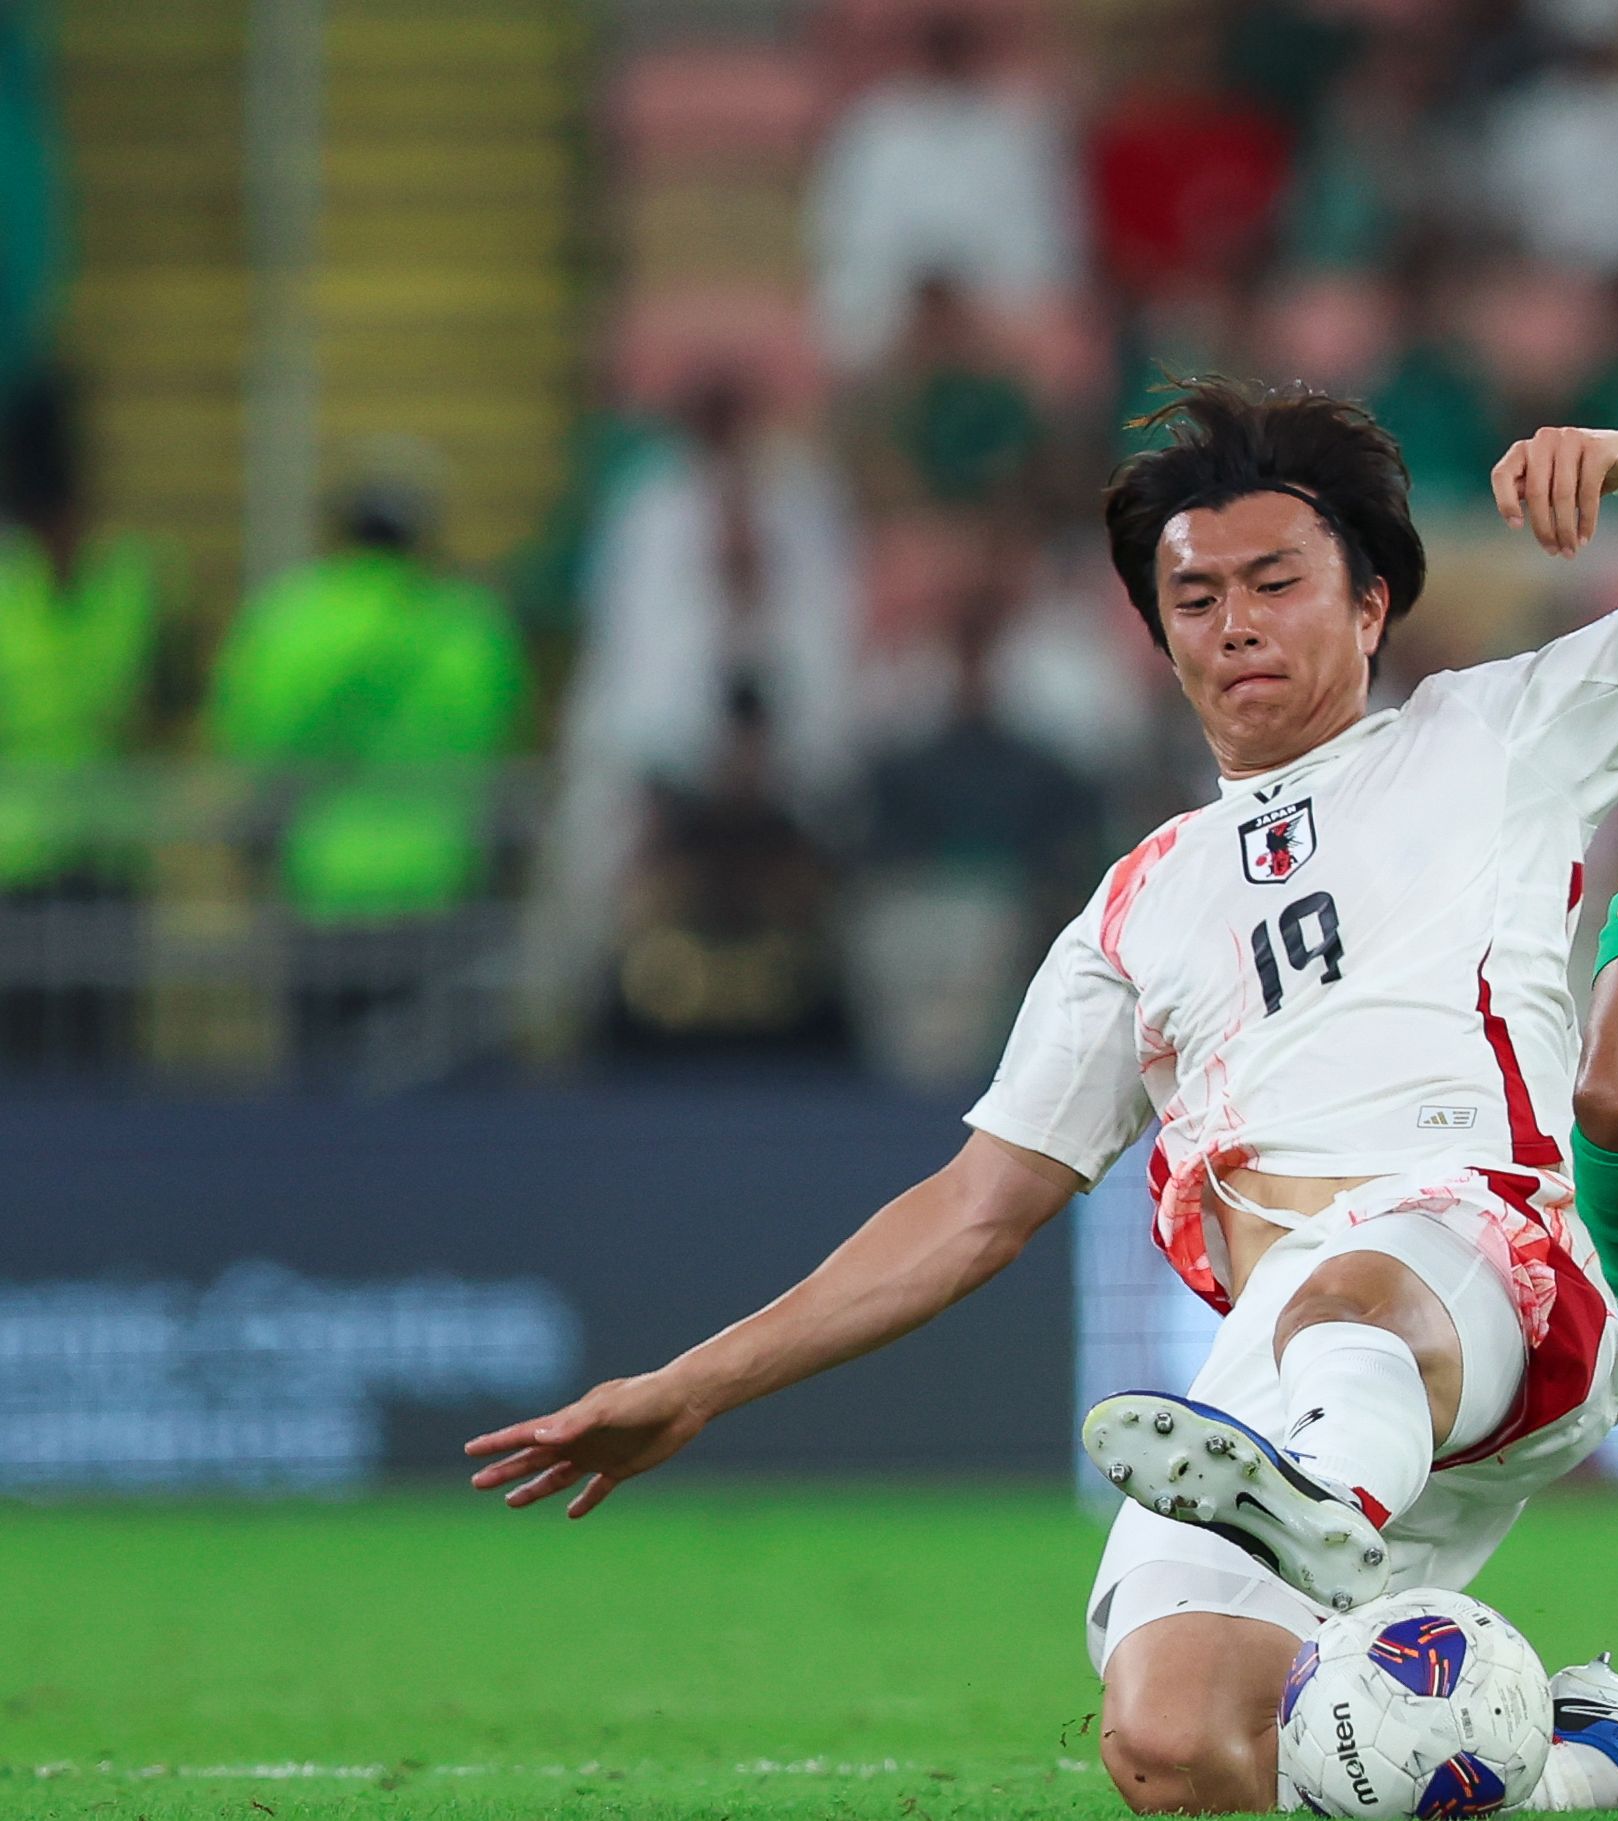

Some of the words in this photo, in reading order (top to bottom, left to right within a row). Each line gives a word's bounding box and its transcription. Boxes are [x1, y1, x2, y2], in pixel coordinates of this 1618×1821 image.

[1255, 804, 1297, 828] JAPAN
[1251, 891, 1345, 1019] 19
[1333, 1702, 1380, 1806] molten
